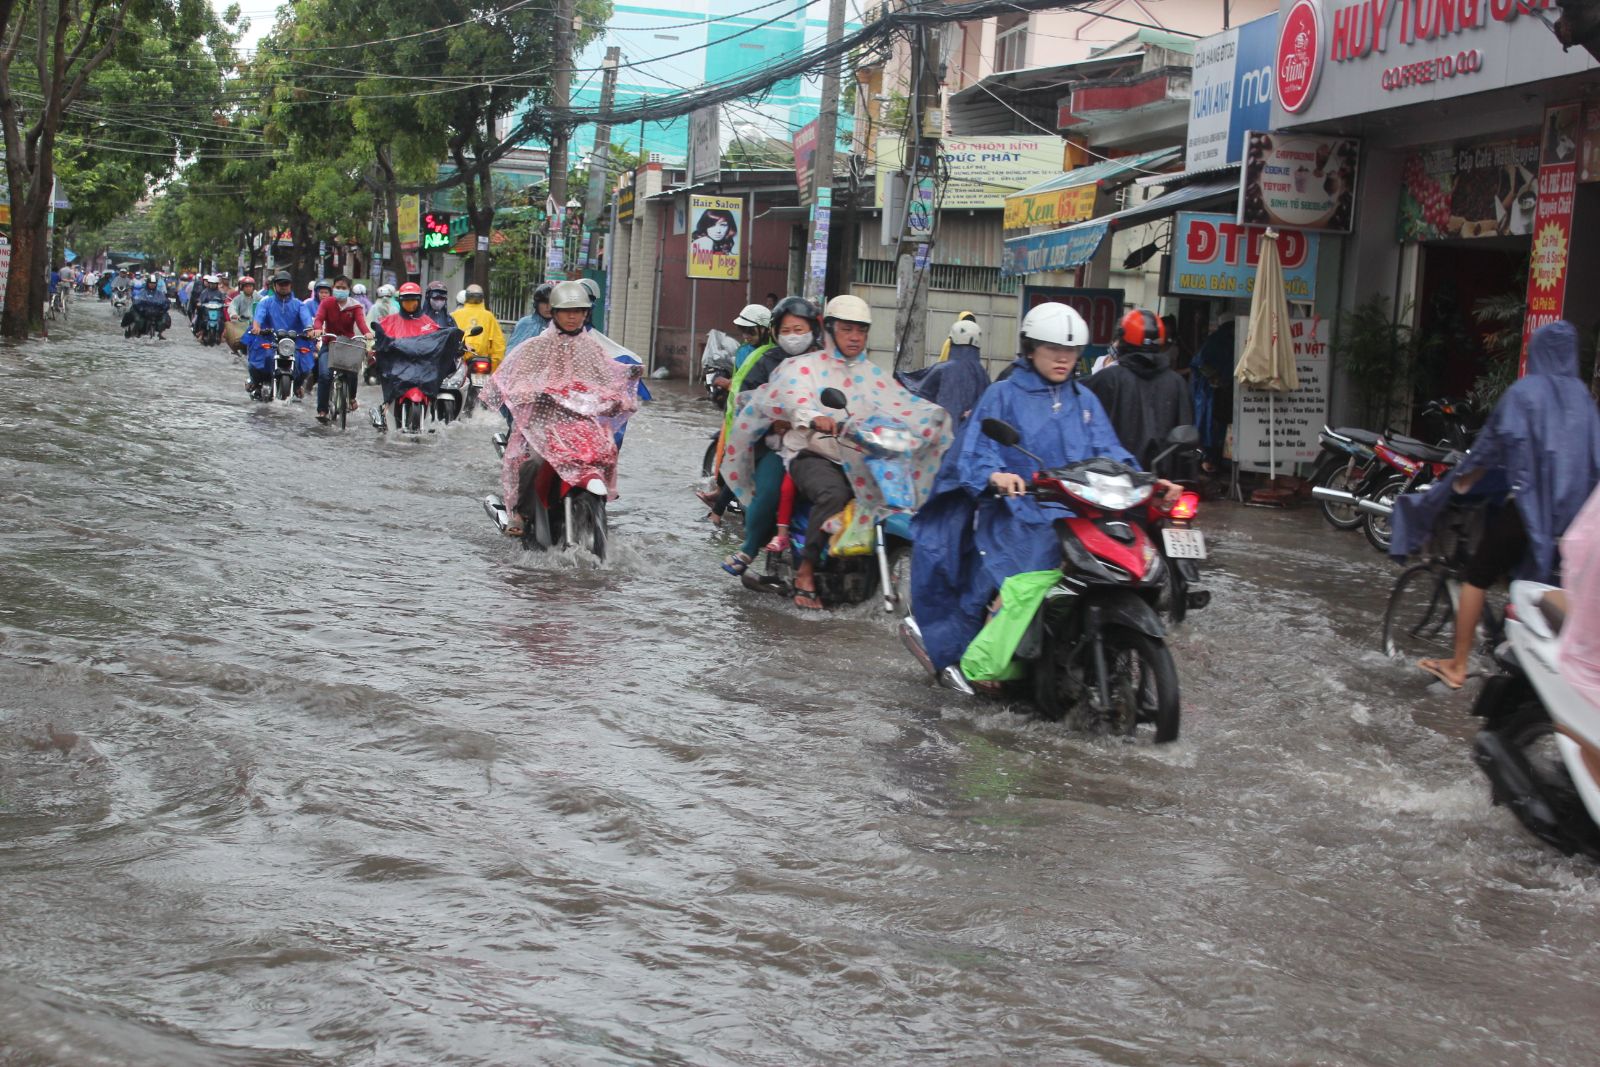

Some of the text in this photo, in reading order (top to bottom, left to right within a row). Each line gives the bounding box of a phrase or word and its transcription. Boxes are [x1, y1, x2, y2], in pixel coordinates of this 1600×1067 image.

[1381, 60, 1433, 91] COFFEE
[1434, 55, 1453, 80] TO
[692, 198, 740, 209] Hair Salon
[1023, 197, 1055, 222] Kem
[1180, 273, 1207, 289] MUA
[1210, 271, 1237, 292] BÁN
[1305, 340, 1326, 358] VẶT
